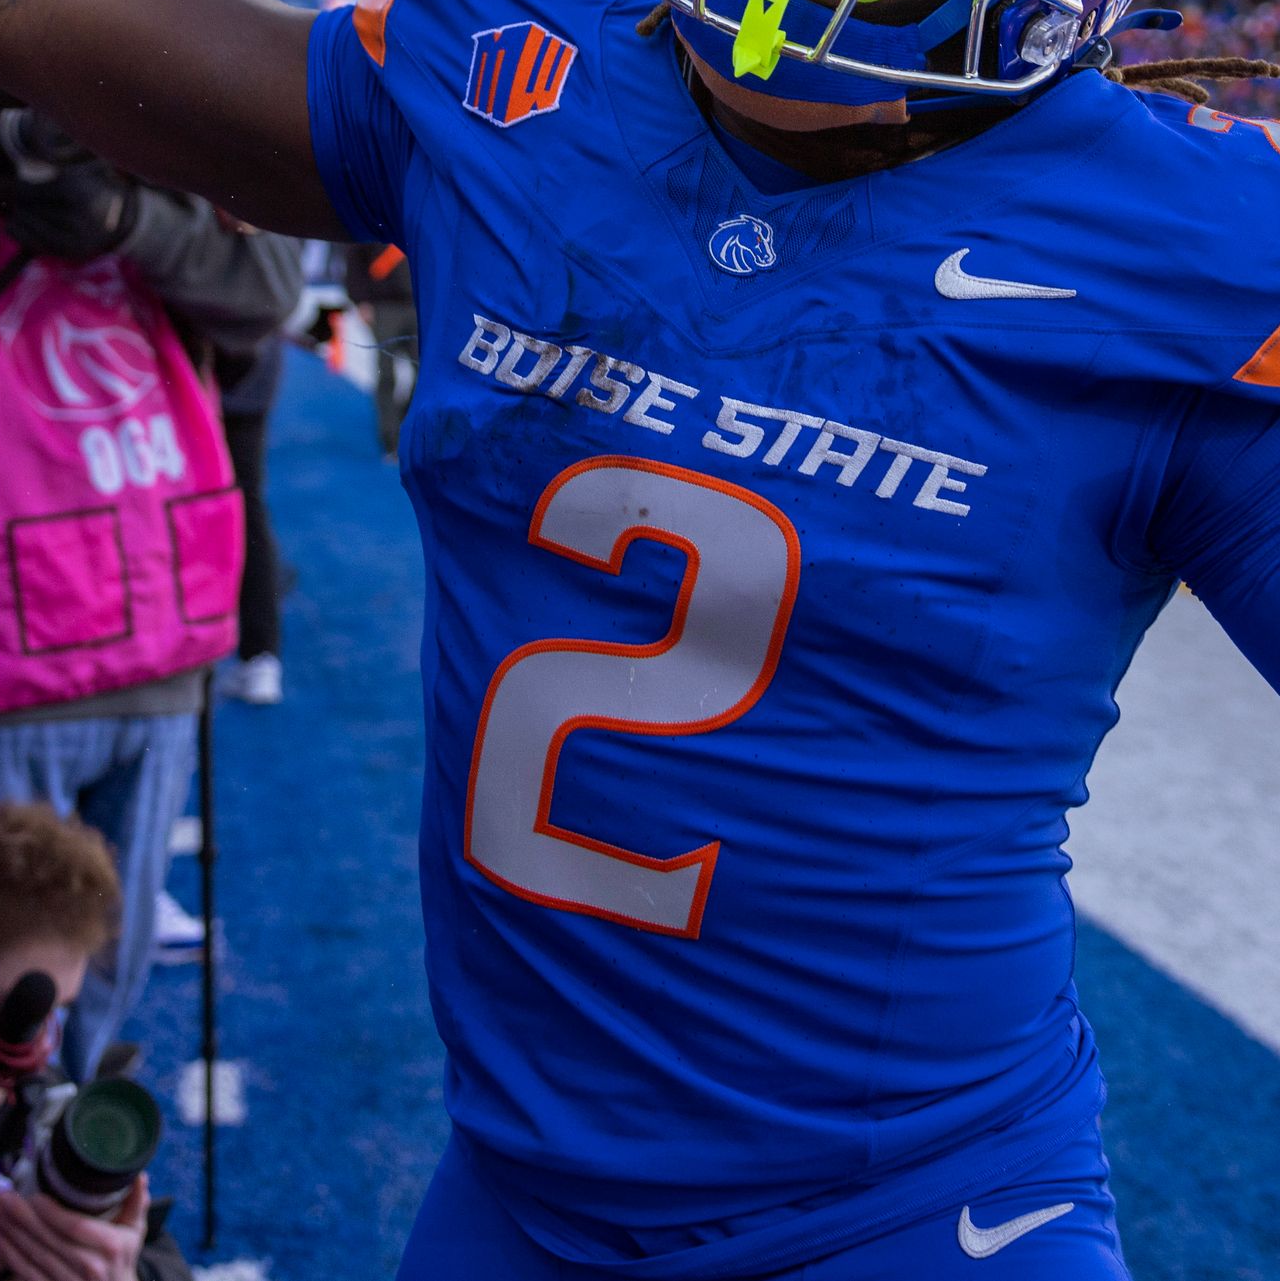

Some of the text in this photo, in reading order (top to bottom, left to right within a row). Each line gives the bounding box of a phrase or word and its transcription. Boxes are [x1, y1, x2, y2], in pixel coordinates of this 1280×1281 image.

[80, 412, 187, 496] 064
[458, 313, 988, 517] BOISE STATE
[464, 454, 801, 939] 2
